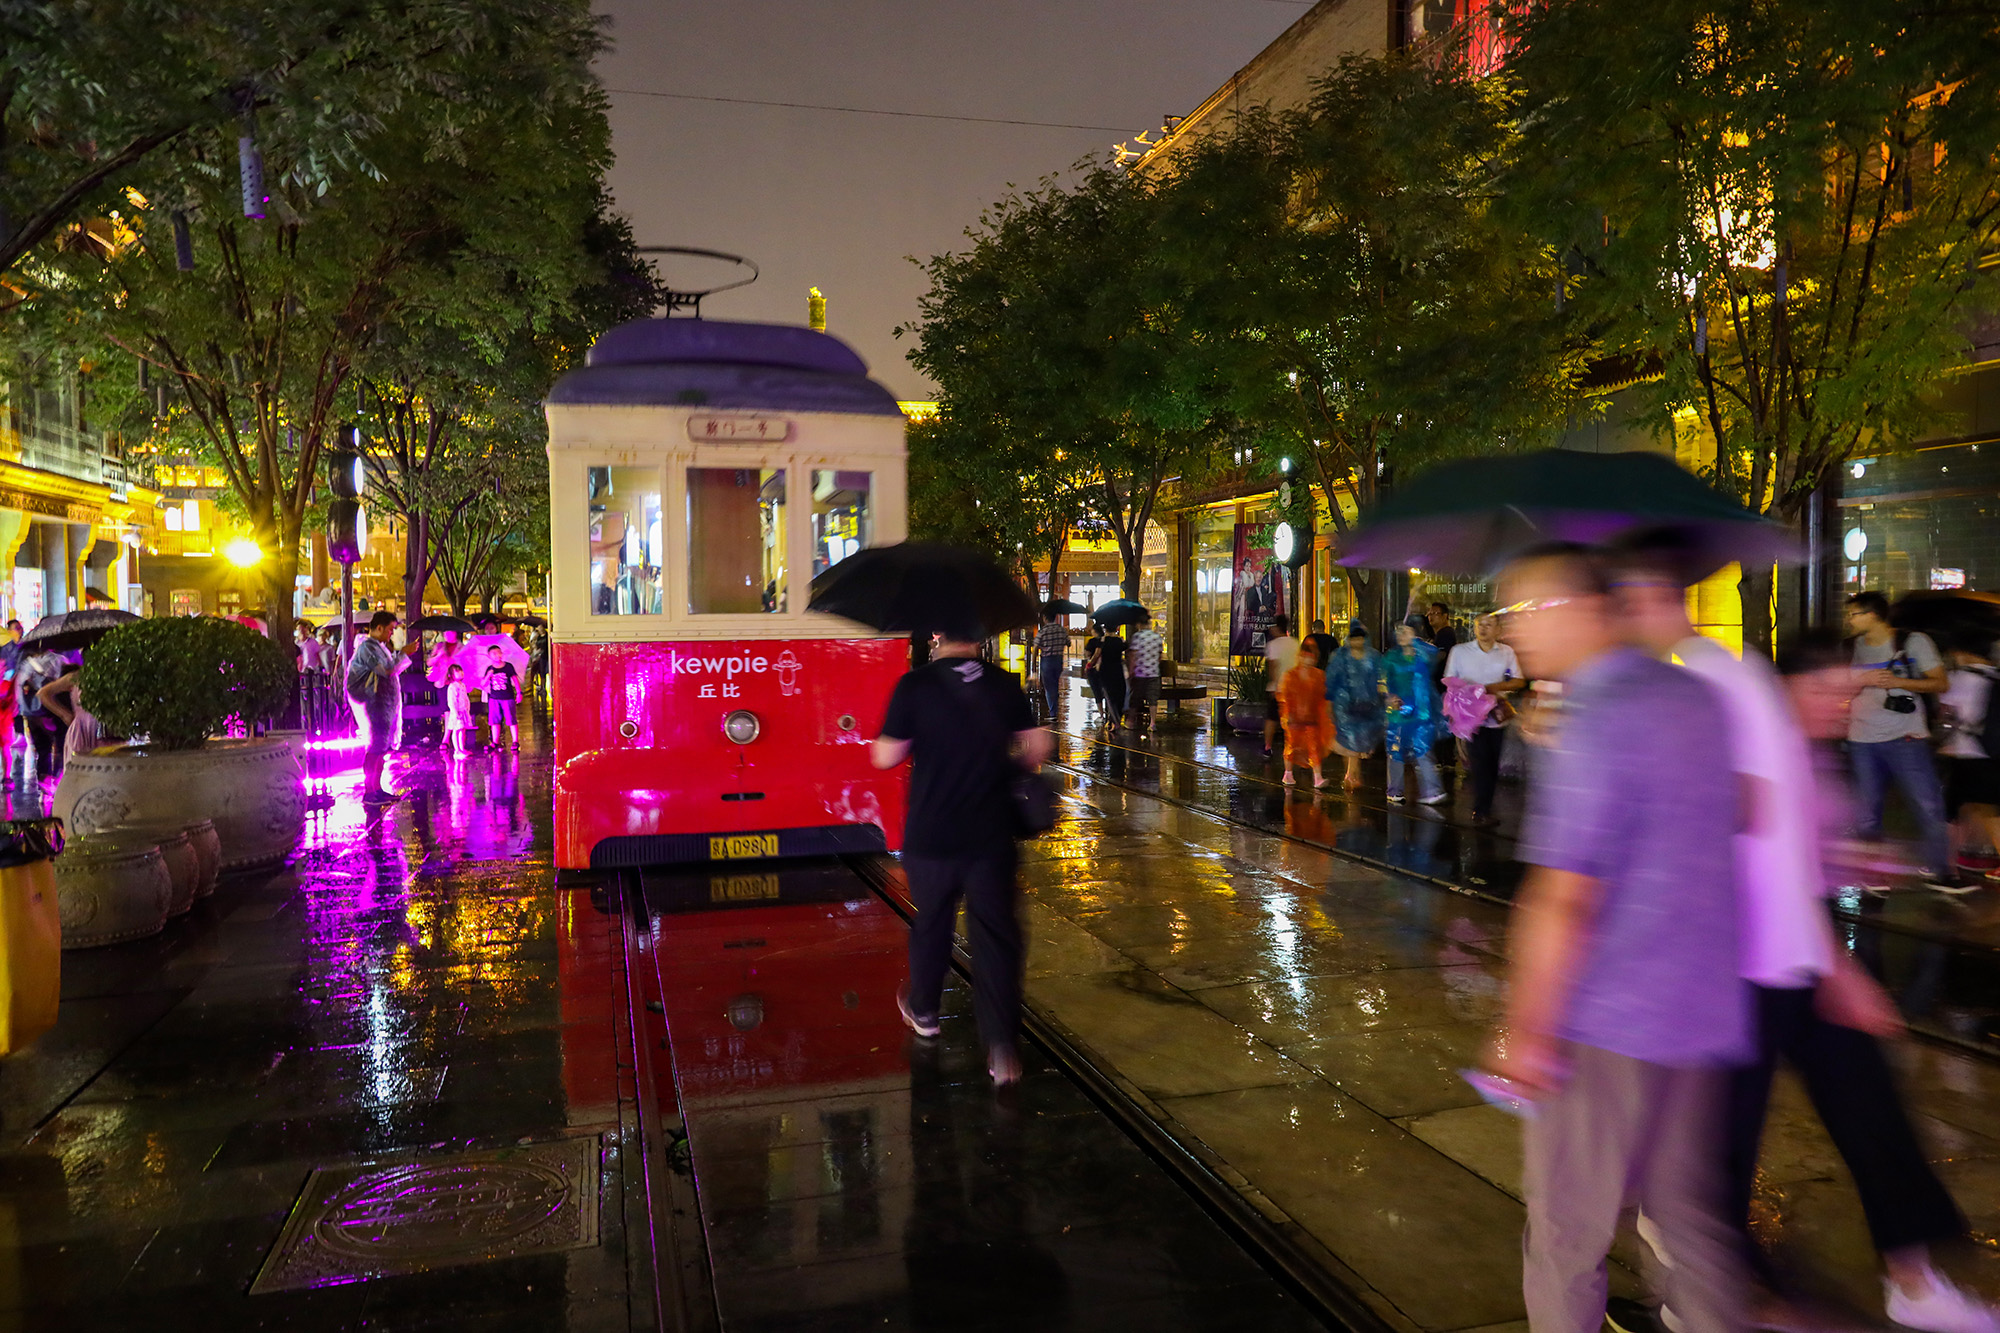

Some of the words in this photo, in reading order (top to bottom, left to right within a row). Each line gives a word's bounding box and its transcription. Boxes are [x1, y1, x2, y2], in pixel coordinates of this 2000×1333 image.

[1459, 583, 1487, 593] AVENUE
[671, 649, 768, 680] kewpie
[697, 683, 741, 698] 丘比
